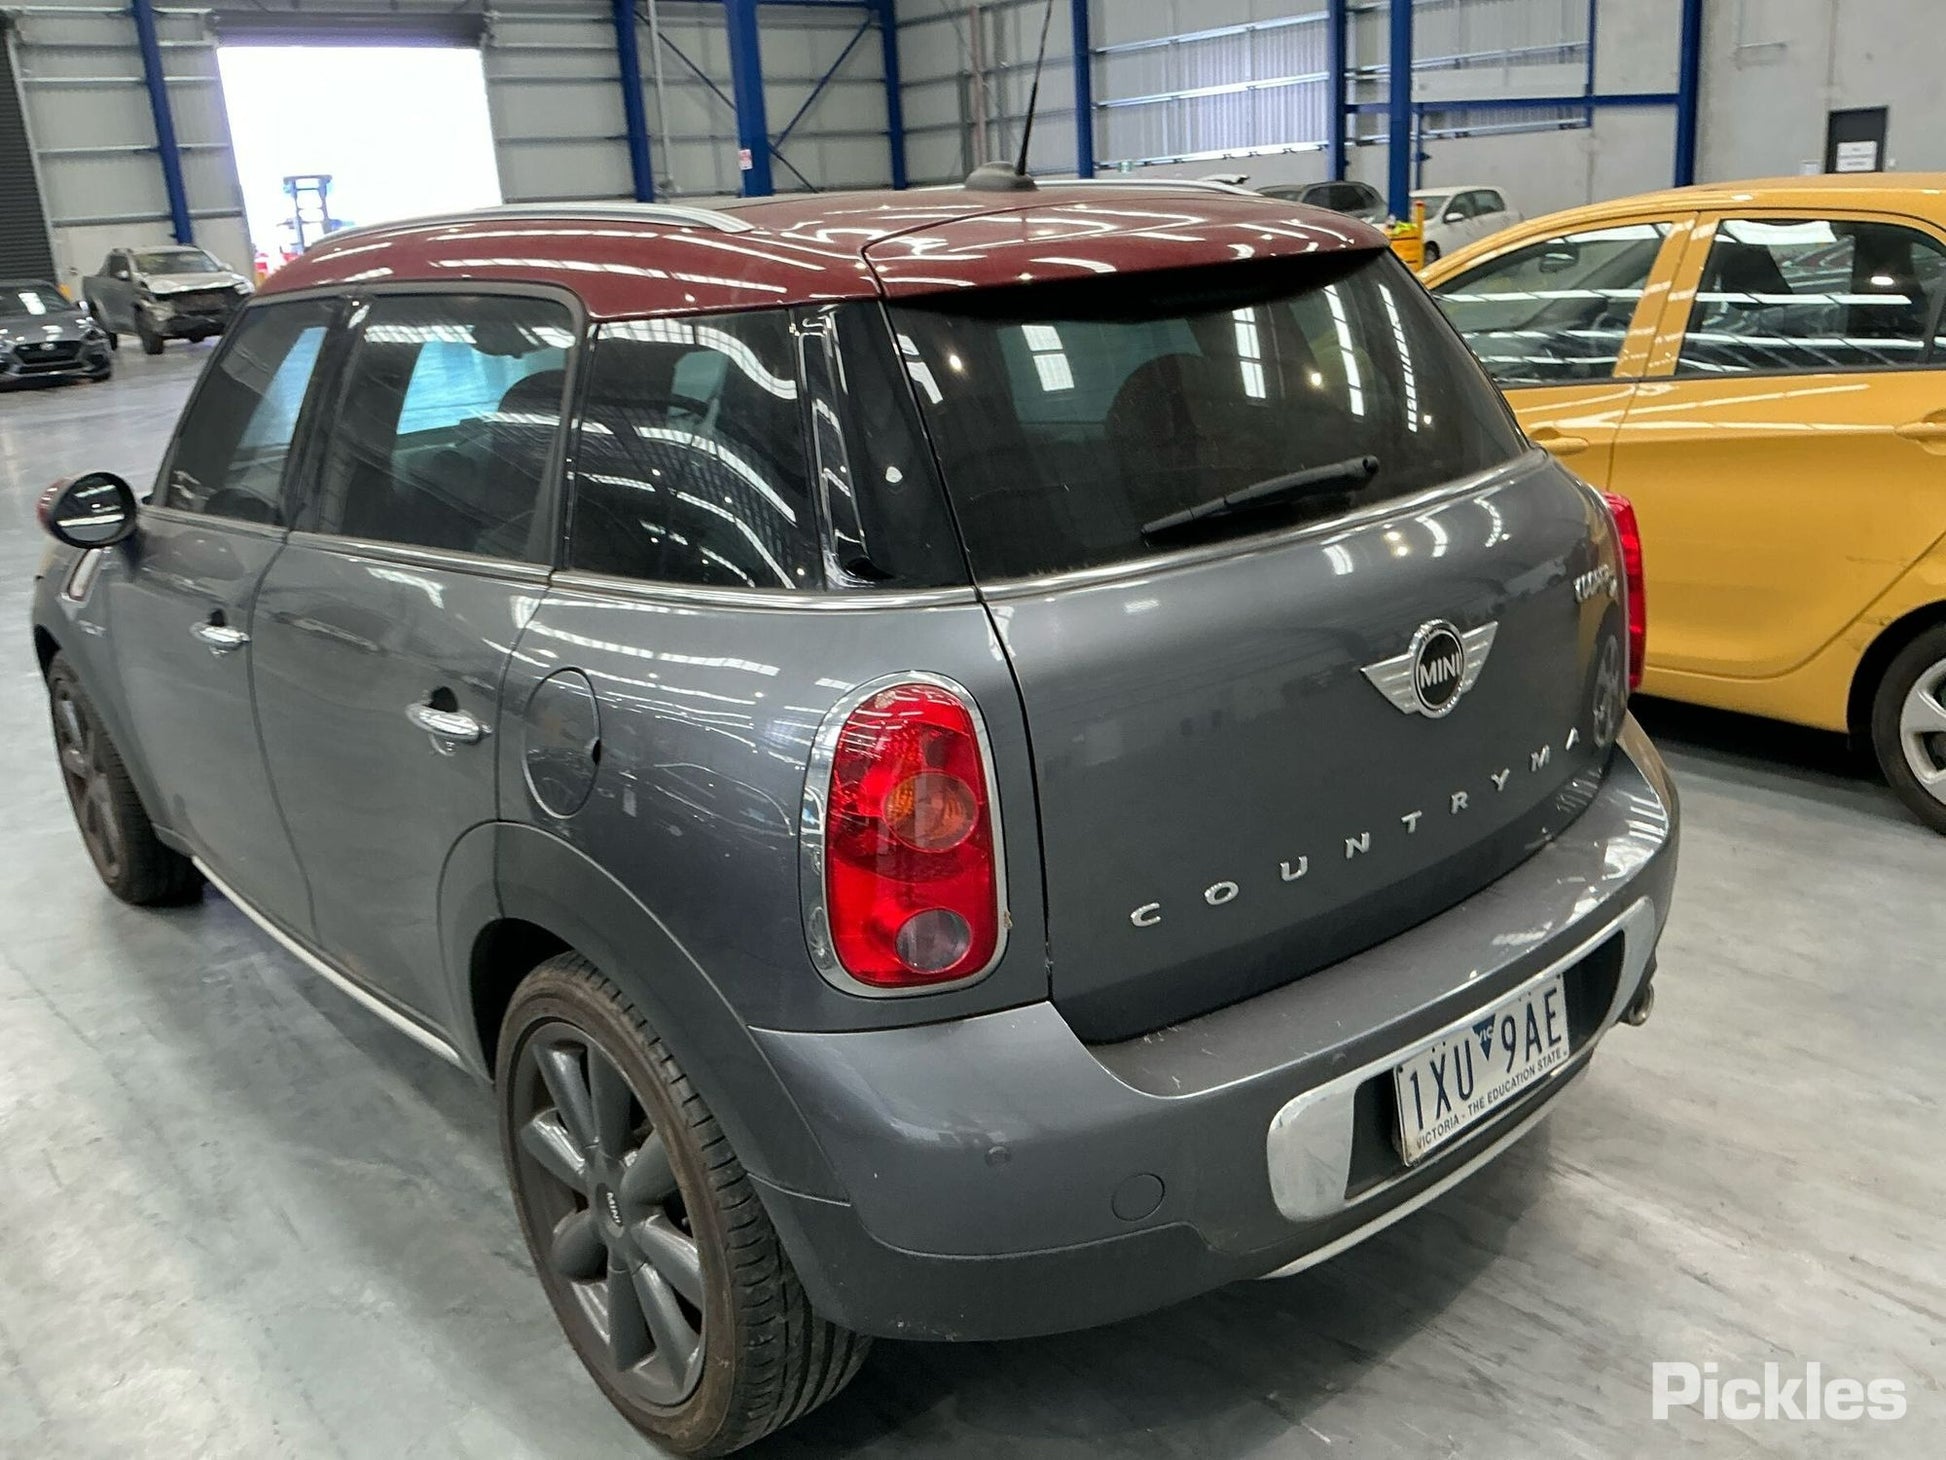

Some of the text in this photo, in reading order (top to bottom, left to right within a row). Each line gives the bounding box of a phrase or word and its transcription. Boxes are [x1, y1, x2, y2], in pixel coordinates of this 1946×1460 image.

[1420, 651, 1461, 689] MINI
[1130, 706, 1605, 927] COUNTRYMA
[1410, 986, 1562, 1132] 1XU 9AE
[1479, 1024, 1494, 1042] VIC
[1416, 1117, 1460, 1150] VICTORIA
[1467, 1096, 1485, 1117] THE
[1487, 1067, 1536, 1105] EDUCATION
[1537, 1047, 1562, 1071] STATE
[606, 1191, 622, 1224] MINI
